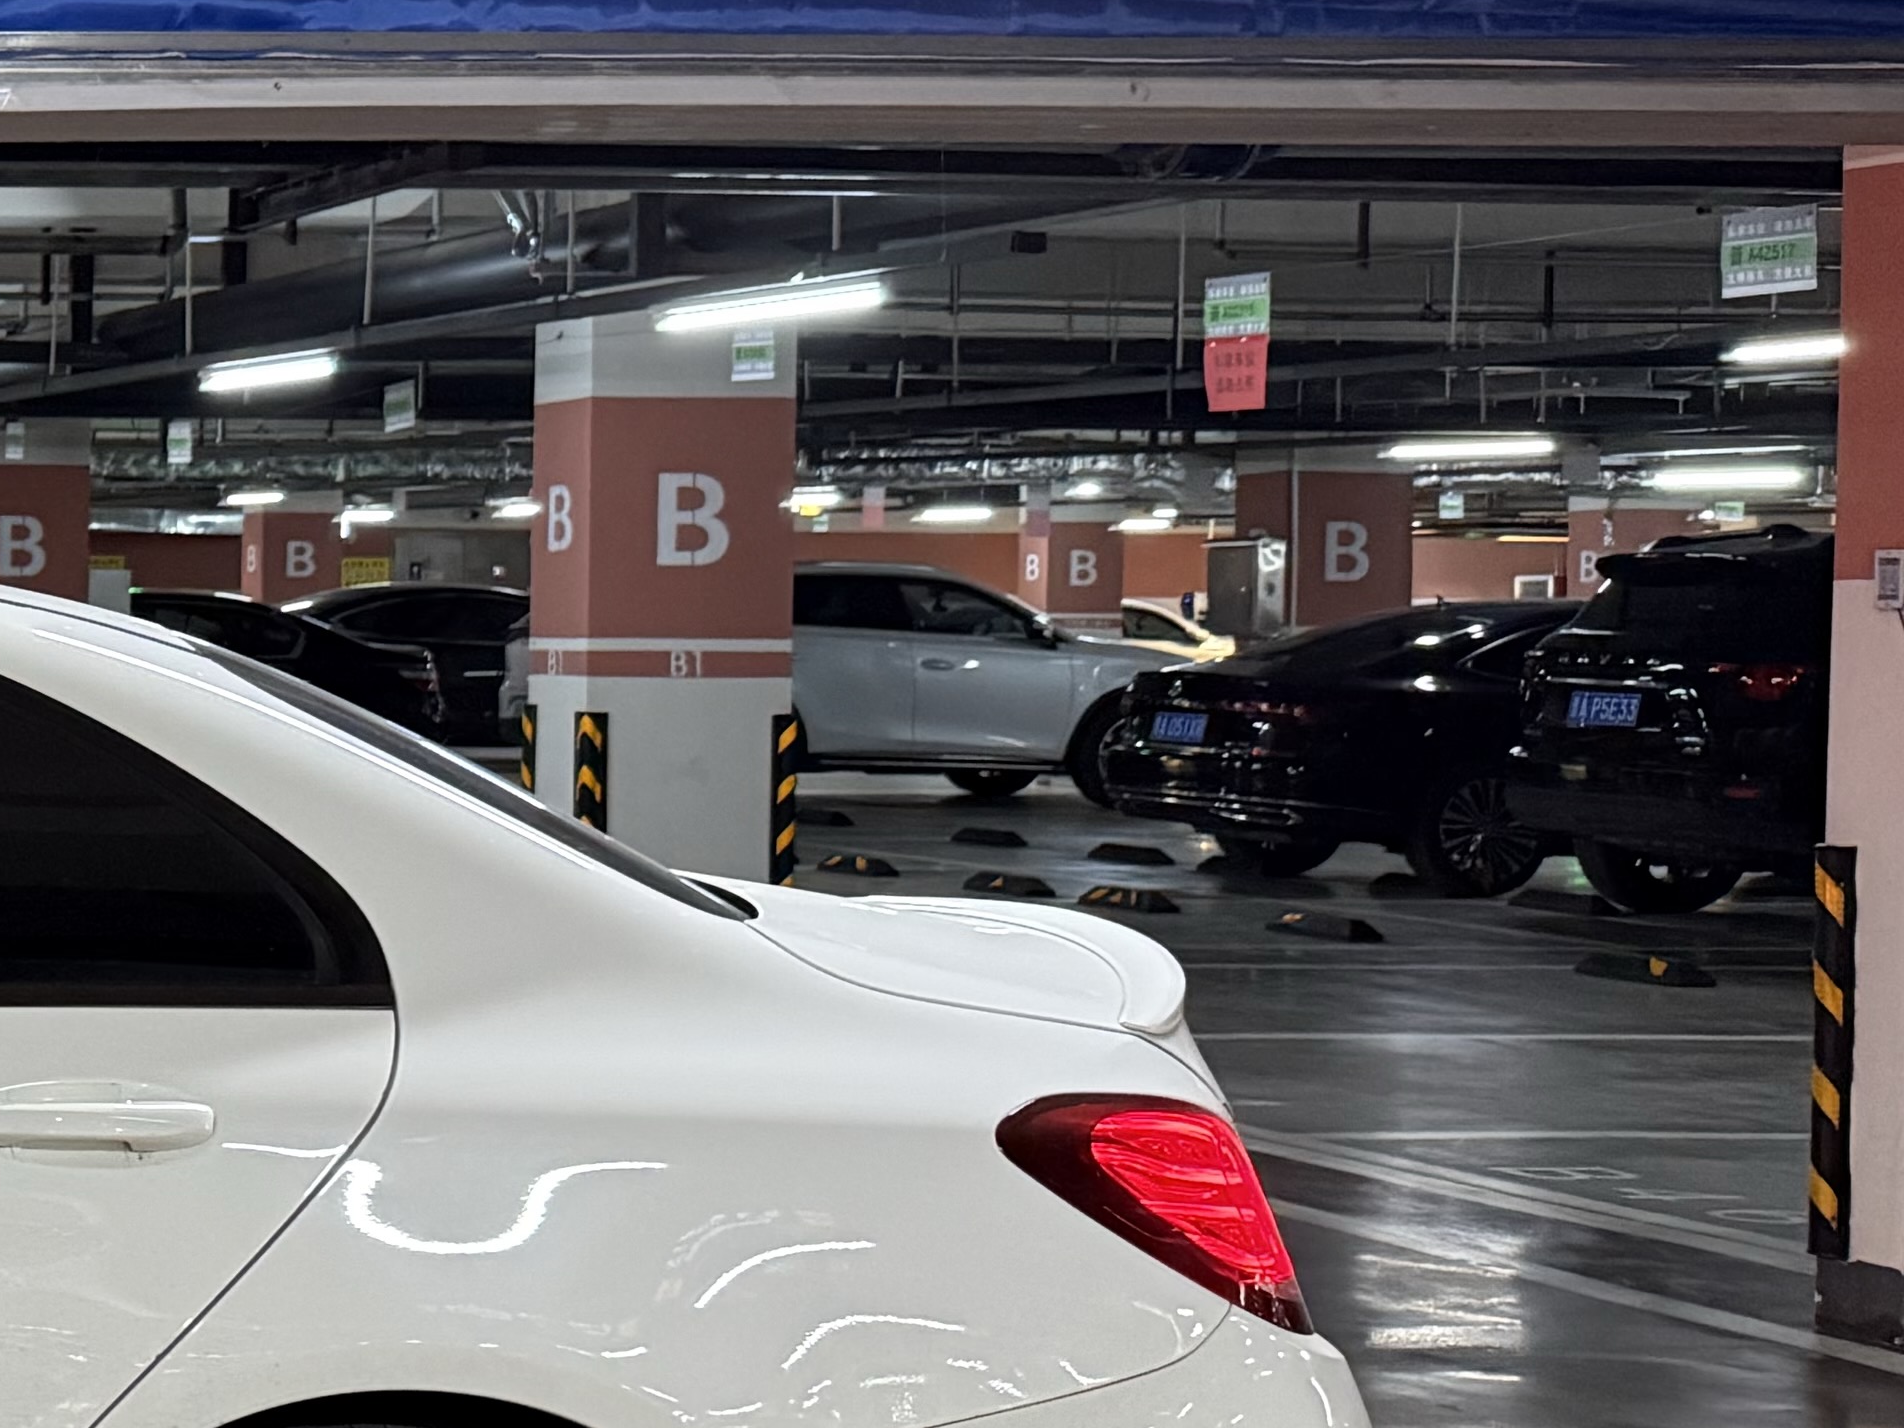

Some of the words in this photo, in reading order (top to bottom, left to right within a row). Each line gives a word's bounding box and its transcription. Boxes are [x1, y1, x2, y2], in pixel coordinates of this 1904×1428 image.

[547, 484, 573, 552] B
[656, 472, 730, 566] B
[286, 540, 316, 578] B
[1069, 549, 1098, 587] B
[1324, 521, 1370, 582] B
[1580, 550, 1599, 583] B
[670, 650, 702, 676] B1
